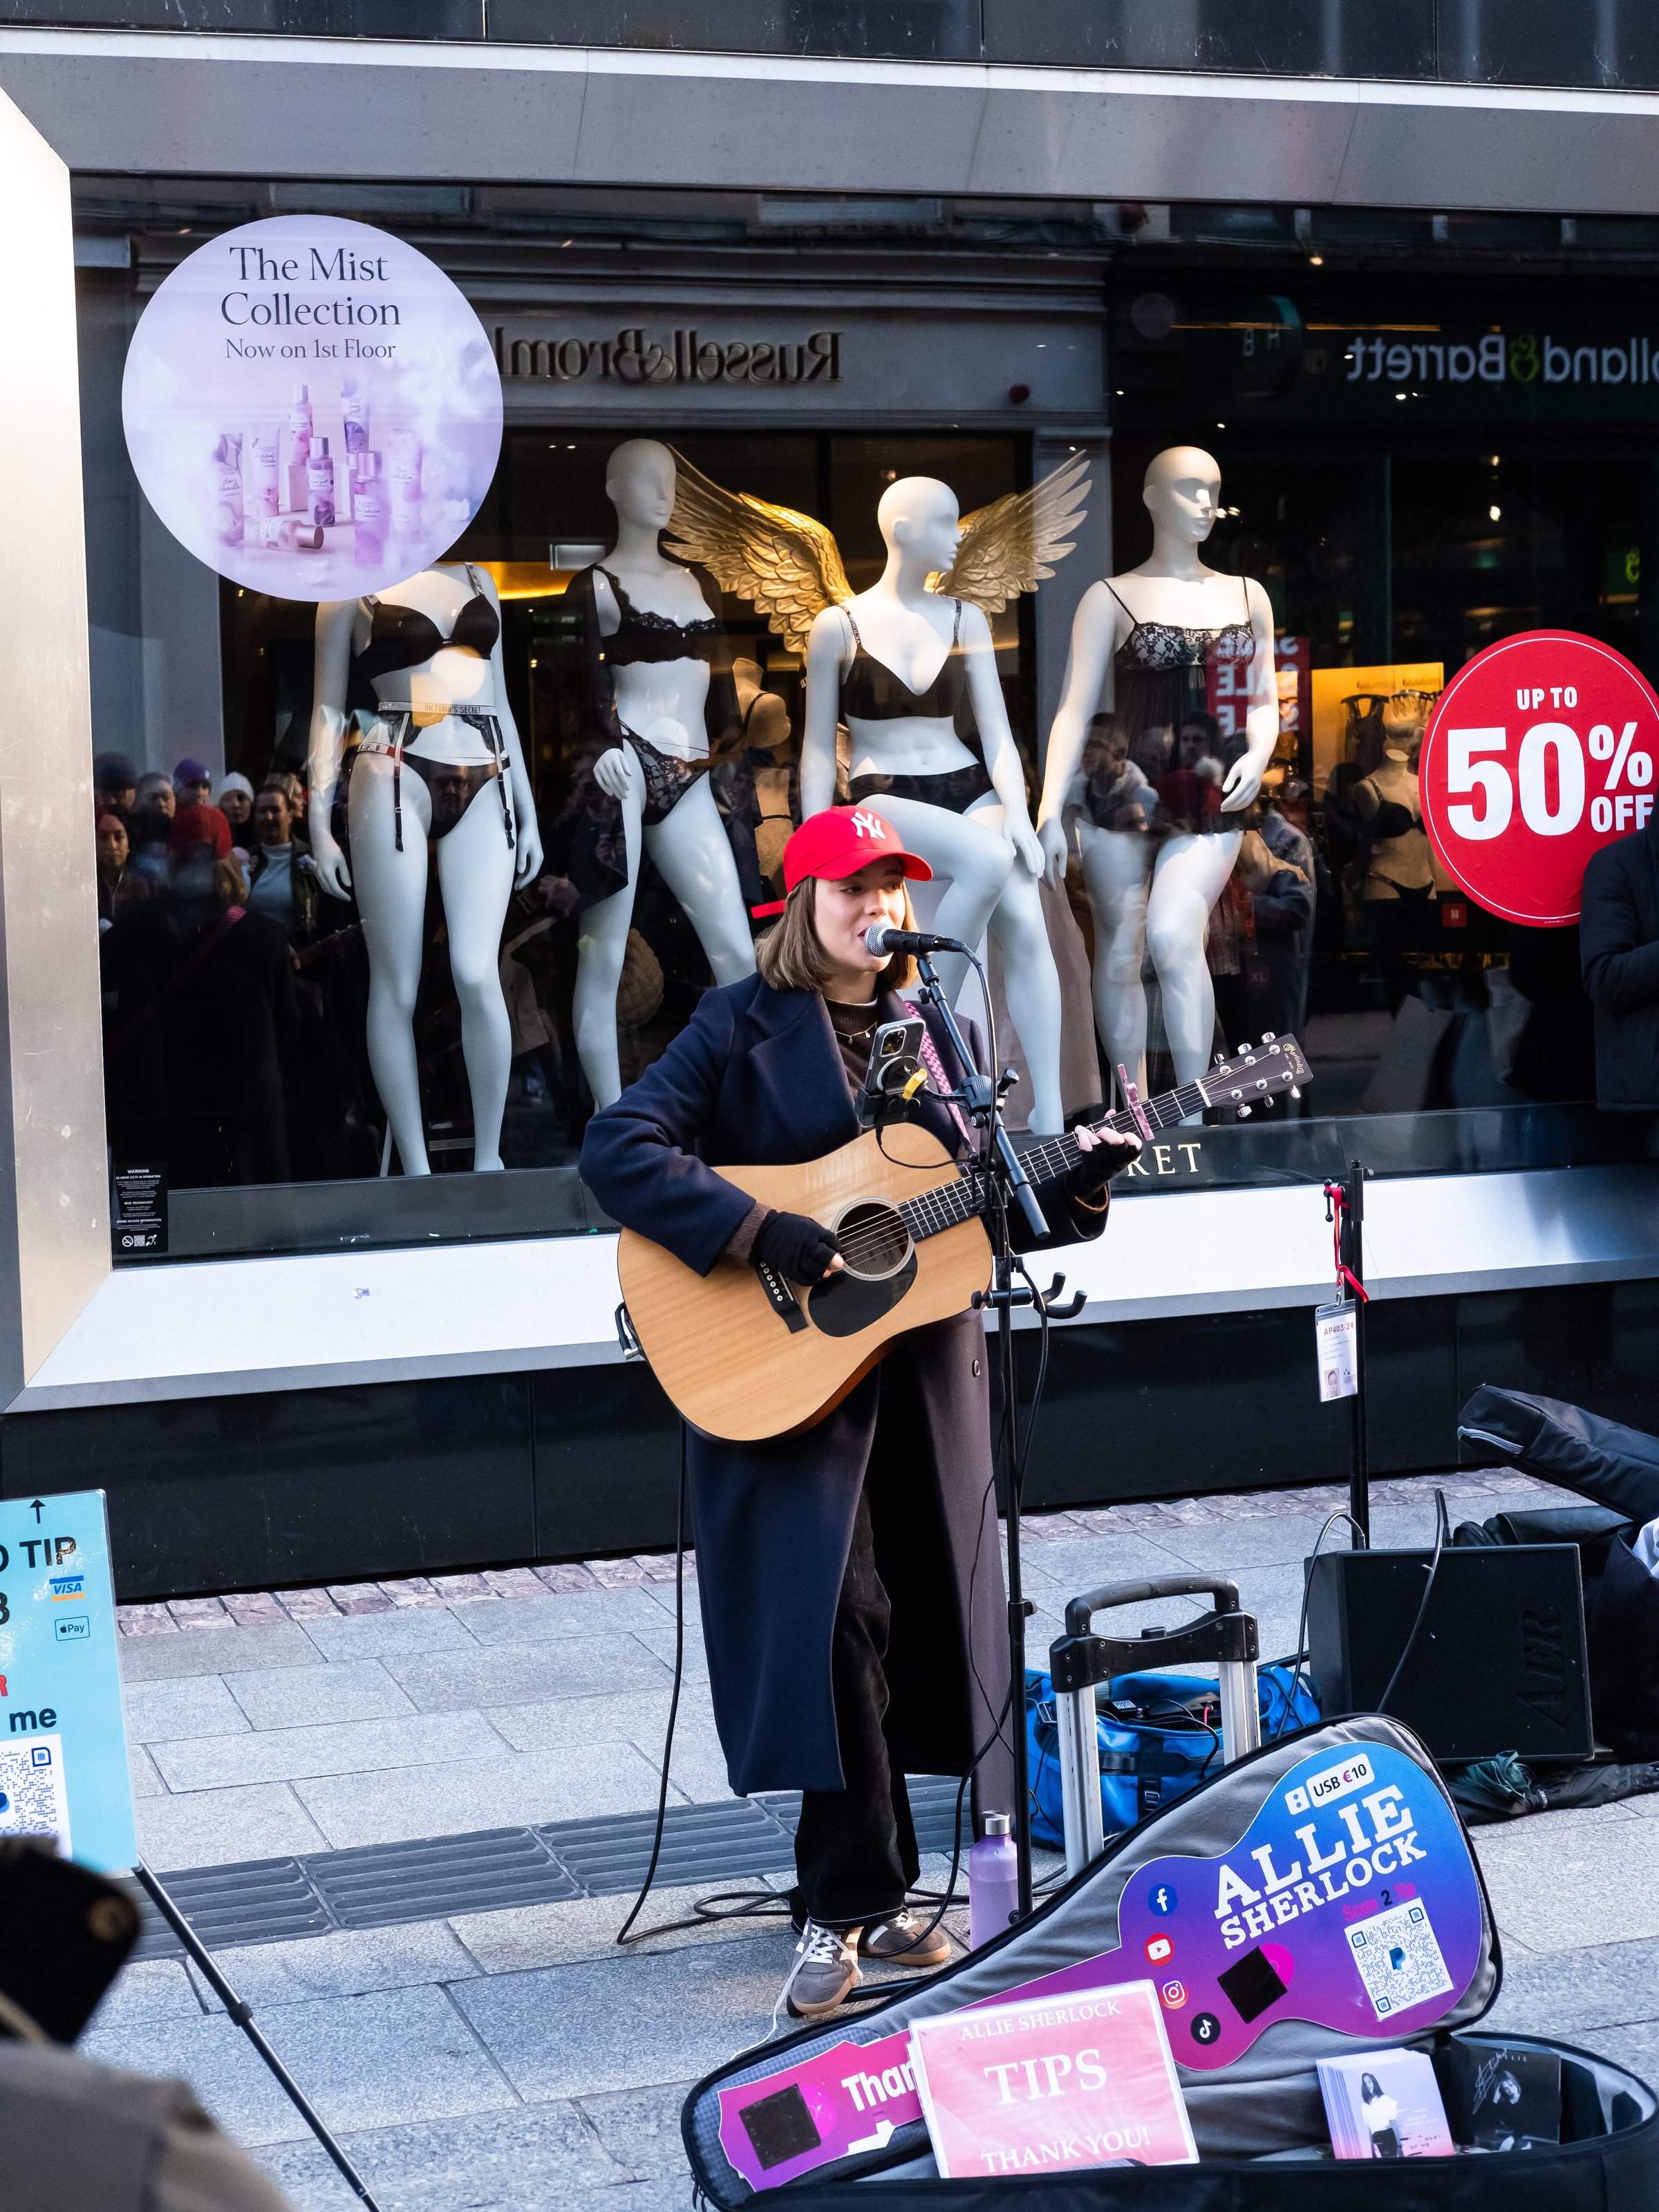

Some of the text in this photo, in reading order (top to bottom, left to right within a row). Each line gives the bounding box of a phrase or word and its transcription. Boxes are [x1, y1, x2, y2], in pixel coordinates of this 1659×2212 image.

[229, 246, 390, 282] The Mist
[221, 292, 402, 327] Collection
[225, 339, 396, 359] Now on 1st Floor
[425, 704, 458, 713] VICTORIA'S
[1517, 686, 1577, 710] UP TO
[1447, 722, 1653, 841] 50%
[851, 812, 886, 840] NY
[1590, 794, 1653, 833] OFF
[1324, 1322, 1354, 1335] AP403-24
[19, 1536, 77, 1568] TIP
[53, 1583, 82, 1595] VISA
[68, 1623, 85, 1633] Pay
[9, 1707, 57, 1732] me
[1313, 1763, 1367, 1799] USB €10
[1213, 1784, 1415, 1919] ALLIE
[1221, 1830, 1427, 1949] SHERLOCK
[1380, 1890, 1393, 1906] 2
[961, 2000, 1123, 2042] ALLIE SHERLOCK
[984, 2049, 1108, 2106] TIPS
[982, 2127, 1151, 2174] THANK YOU!
